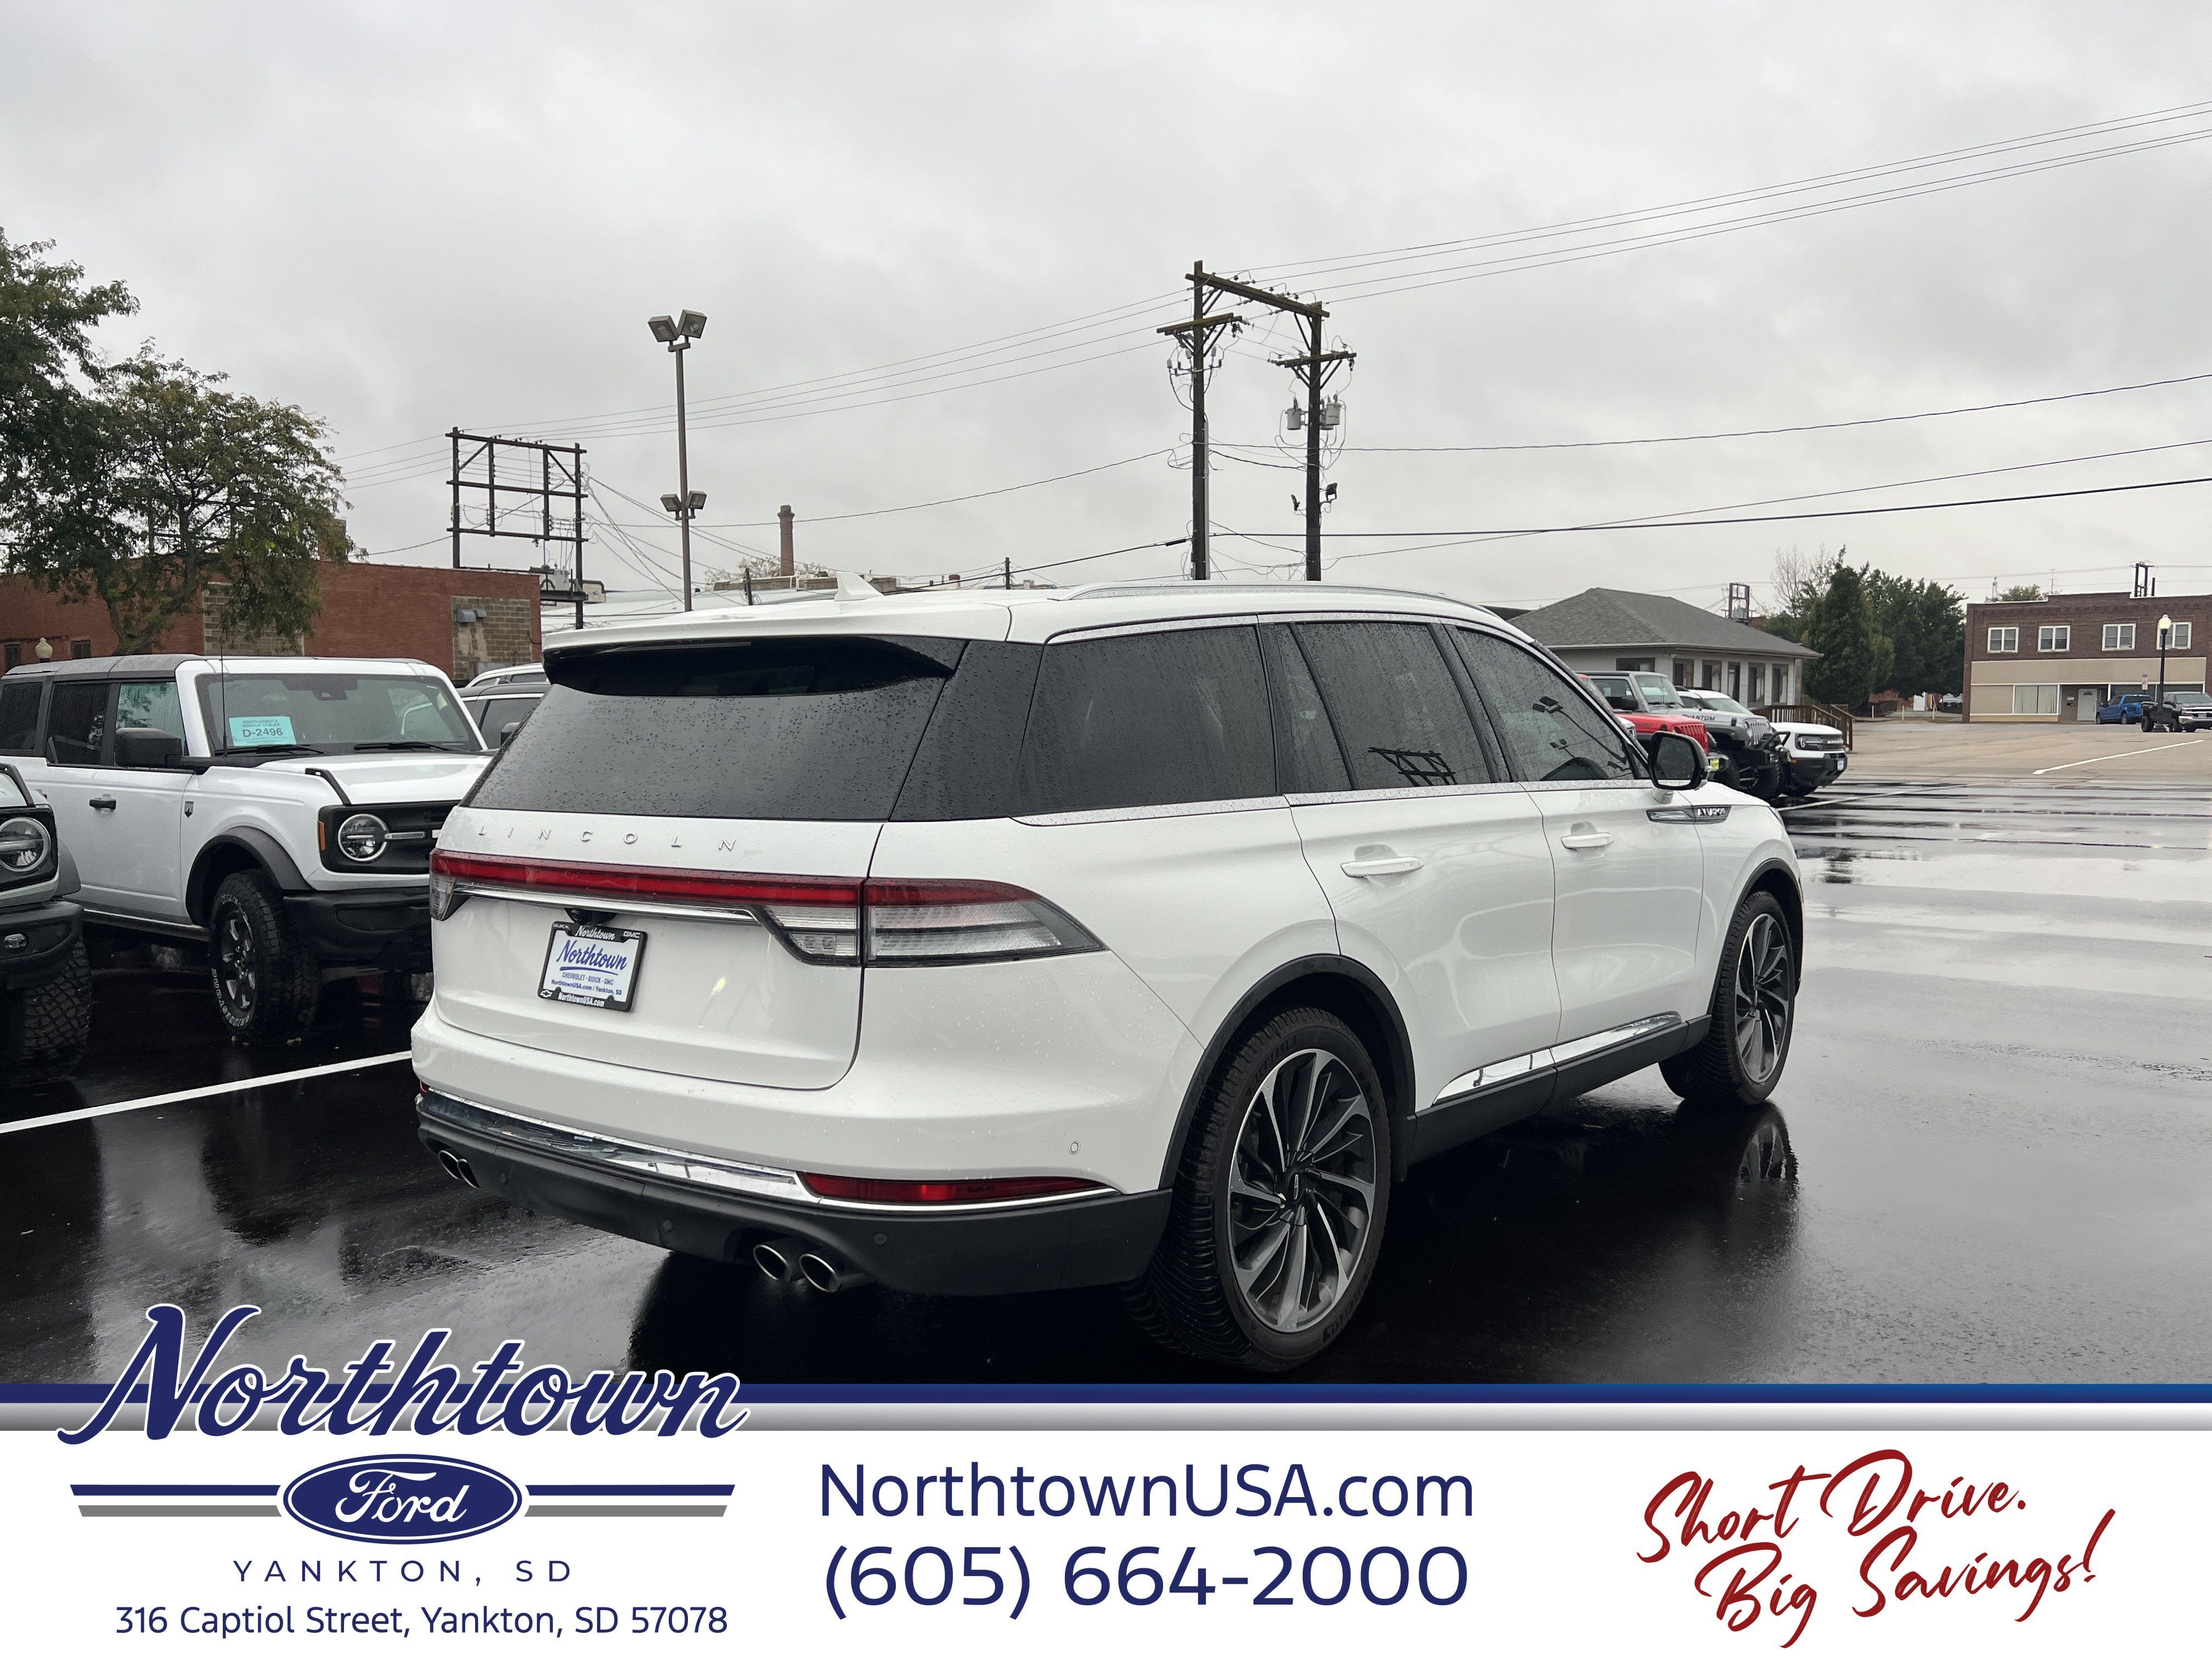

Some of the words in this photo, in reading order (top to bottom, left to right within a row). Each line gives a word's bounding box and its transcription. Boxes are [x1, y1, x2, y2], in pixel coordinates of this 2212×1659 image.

[242, 728, 283, 737] D-2496
[478, 825, 736, 851] LINCOLN
[575, 925, 616, 940] Northtown
[556, 939, 628, 970] Northtown
[562, 972, 585, 980] CHEVROLET
[551, 979, 592, 990] NorthtownUSA.com
[558, 992, 605, 1007] NorthtownUSA.com
